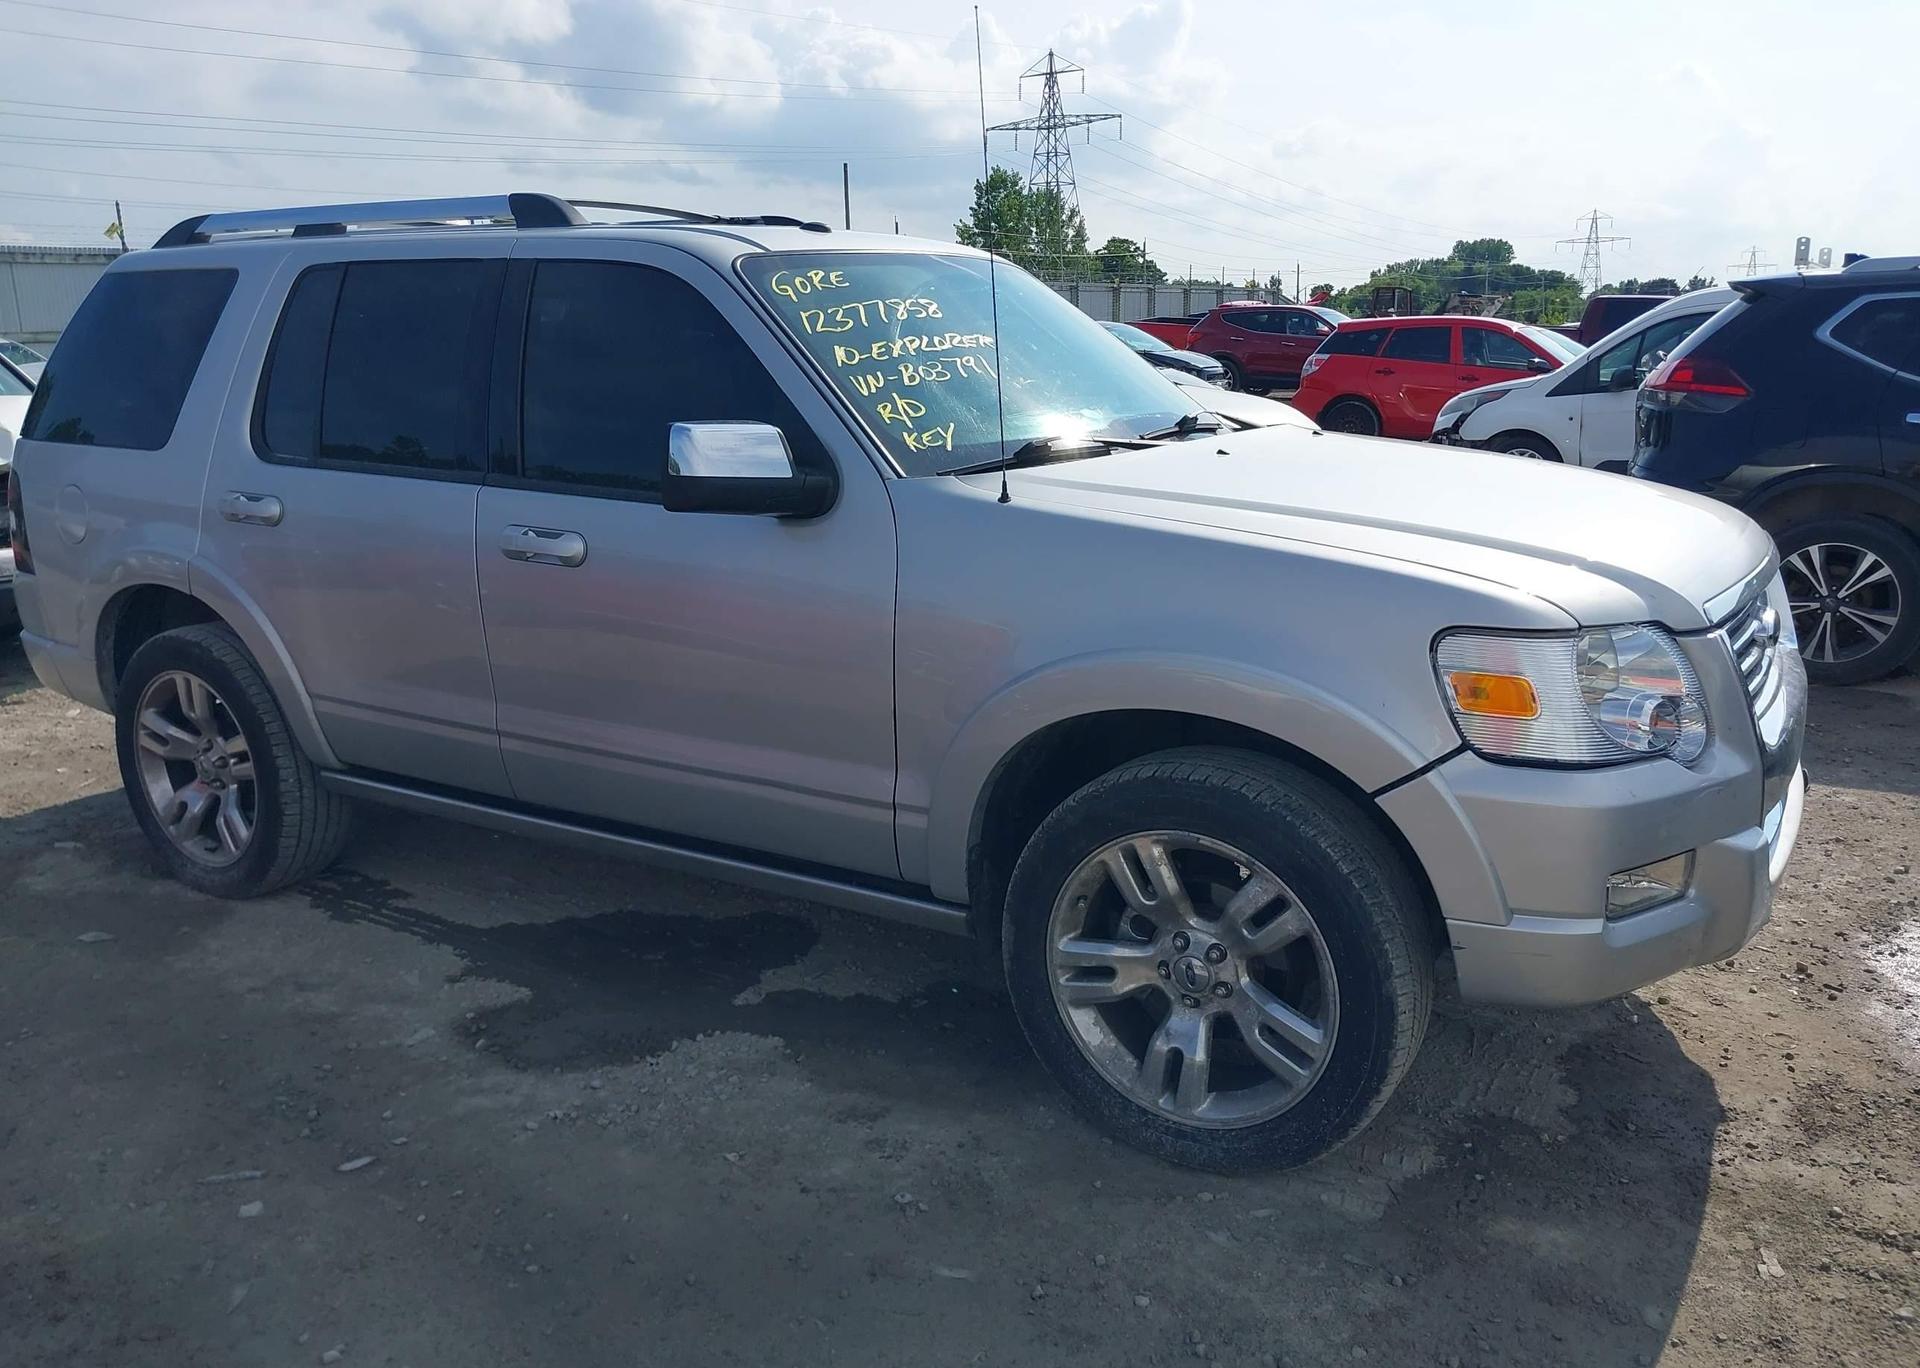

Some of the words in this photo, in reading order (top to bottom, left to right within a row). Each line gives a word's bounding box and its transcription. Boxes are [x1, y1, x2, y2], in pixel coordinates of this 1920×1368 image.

[771, 270, 849, 302] GORE
[876, 393, 925, 428] R/D
[902, 423, 955, 452] KEY
